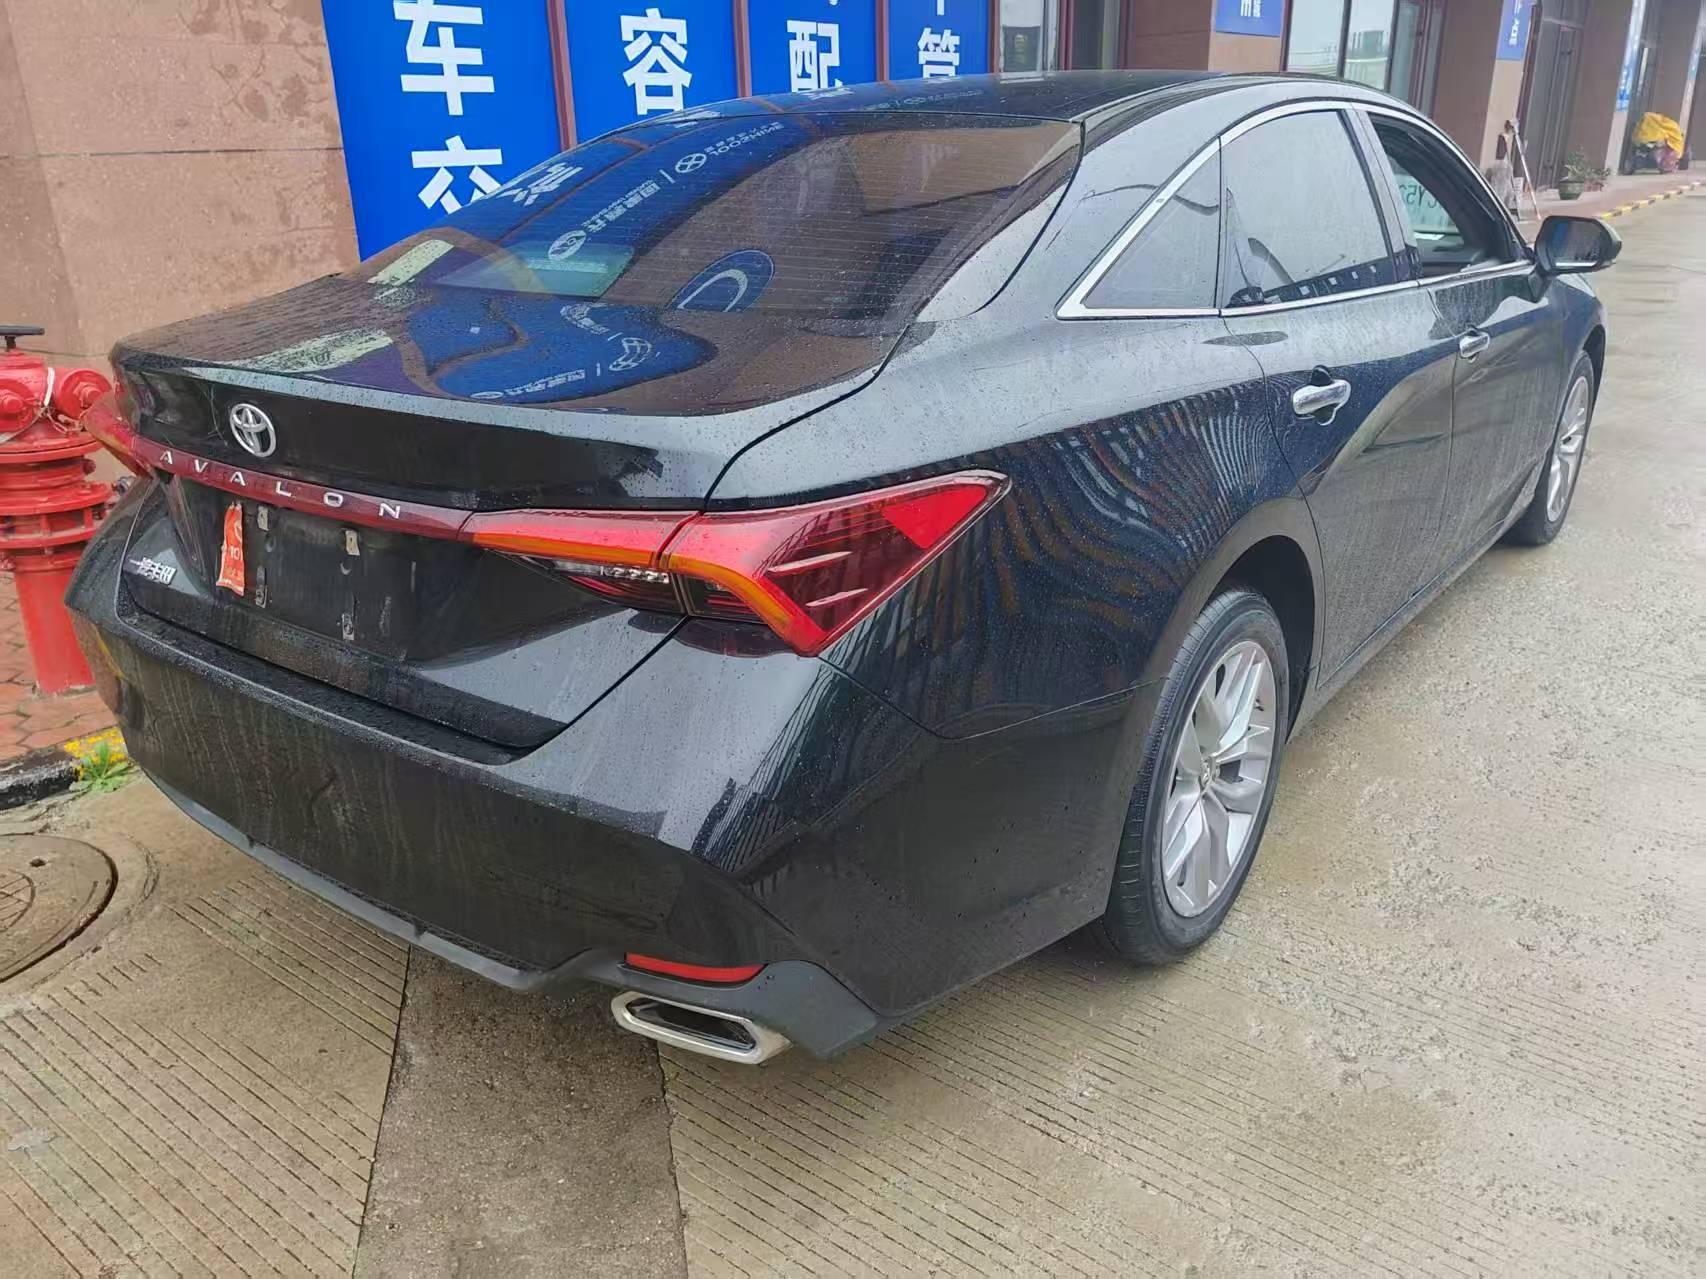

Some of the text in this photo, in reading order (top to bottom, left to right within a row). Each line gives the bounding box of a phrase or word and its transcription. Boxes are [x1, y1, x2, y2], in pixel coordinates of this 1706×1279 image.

[620, 8, 692, 115] 容
[787, 0, 843, 92] 配
[159, 450, 401, 519] AVALON
